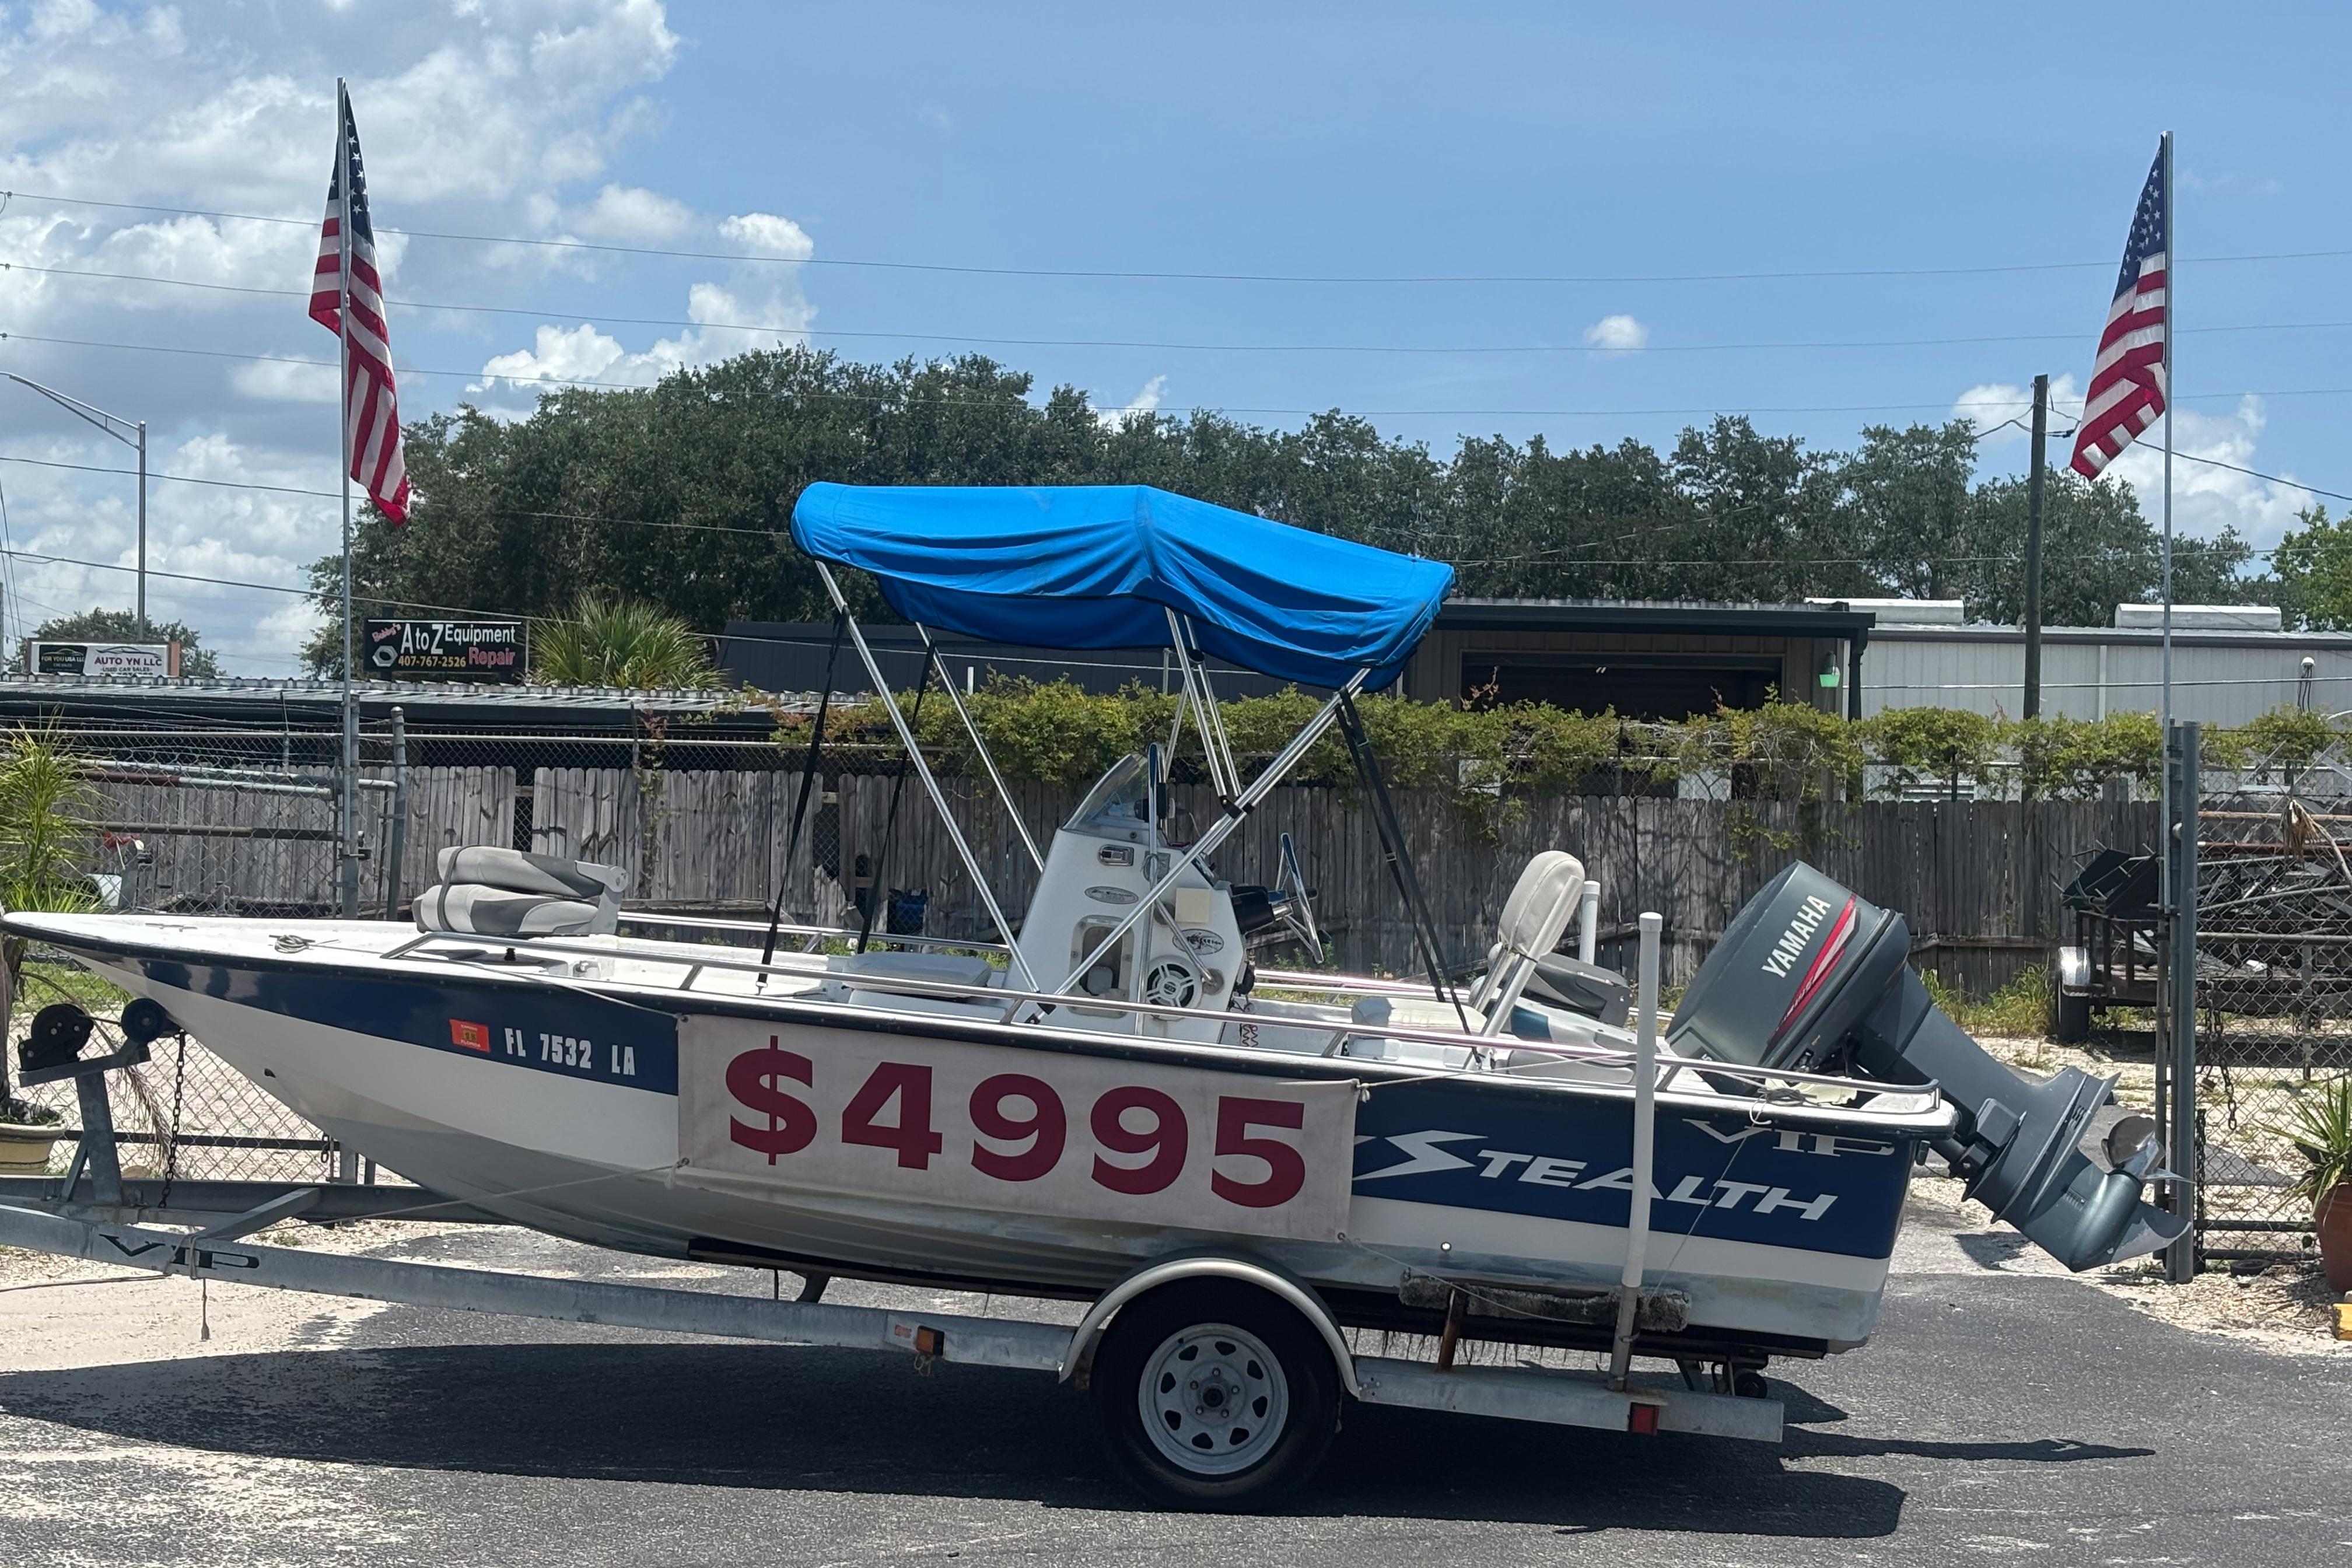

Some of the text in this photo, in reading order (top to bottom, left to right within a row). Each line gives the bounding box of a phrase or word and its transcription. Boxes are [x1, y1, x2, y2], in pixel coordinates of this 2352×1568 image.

[401, 623, 516, 654] A to Z Equipment
[468, 646, 516, 668] Repair
[94, 657, 162, 666] AUTO YN LLC
[398, 656, 467, 667] 407-767-2526
[1761, 895, 1832, 978] YAMAHA
[505, 1028, 635, 1076] FL 7532 LA
[725, 1035, 1306, 1208] $4995
[1352, 1129, 1838, 1221] STEALTH
